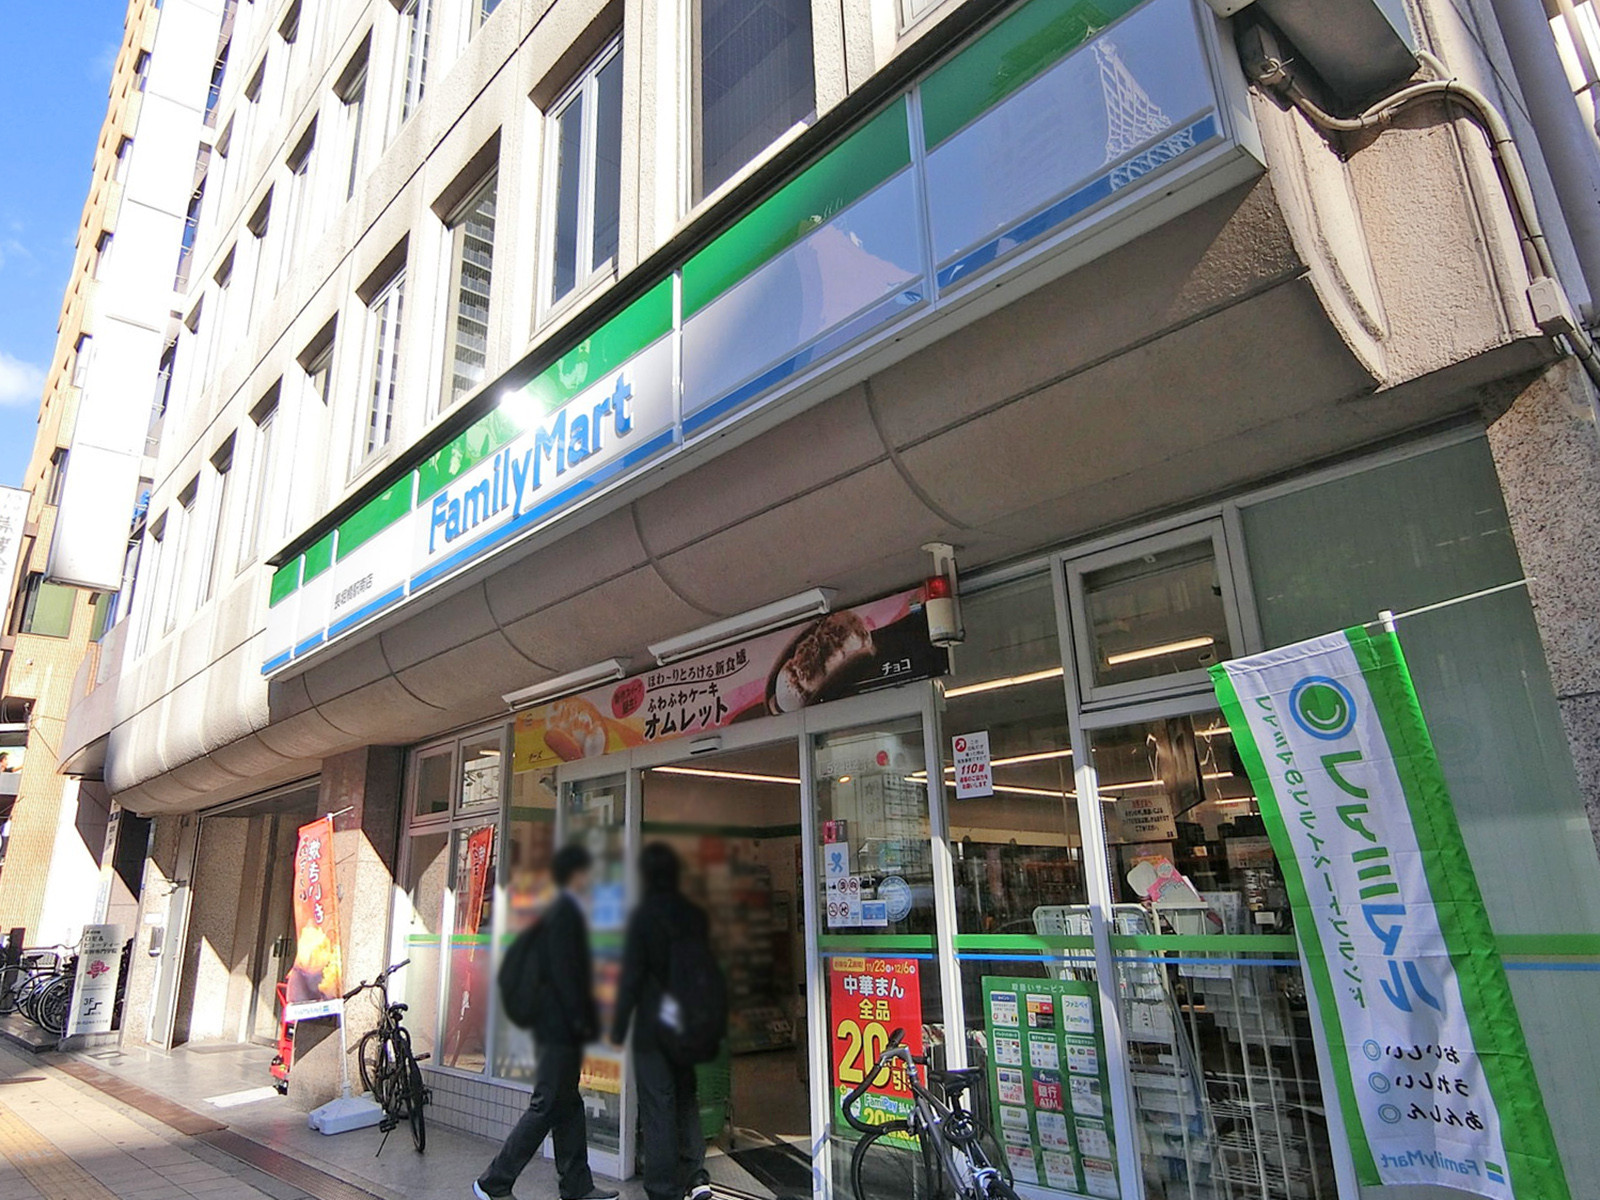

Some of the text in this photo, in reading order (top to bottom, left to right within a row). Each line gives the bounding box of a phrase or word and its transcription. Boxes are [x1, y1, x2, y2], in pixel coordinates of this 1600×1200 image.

[428, 371, 634, 554] FamilyMart
[880, 658, 911, 676] チョコ
[647, 681, 719, 713] ふわふわケーキ
[643, 695, 729, 740] オムレット
[961, 763, 985, 775] 110番
[843, 974, 905, 999] 中華まん
[858, 998, 890, 1021] 全品
[837, 1018, 891, 1088] 20
[864, 1092, 898, 1114] FamiPay
[1038, 1085, 1058, 1099] 銀行
[1039, 1098, 1058, 1108] ATM
